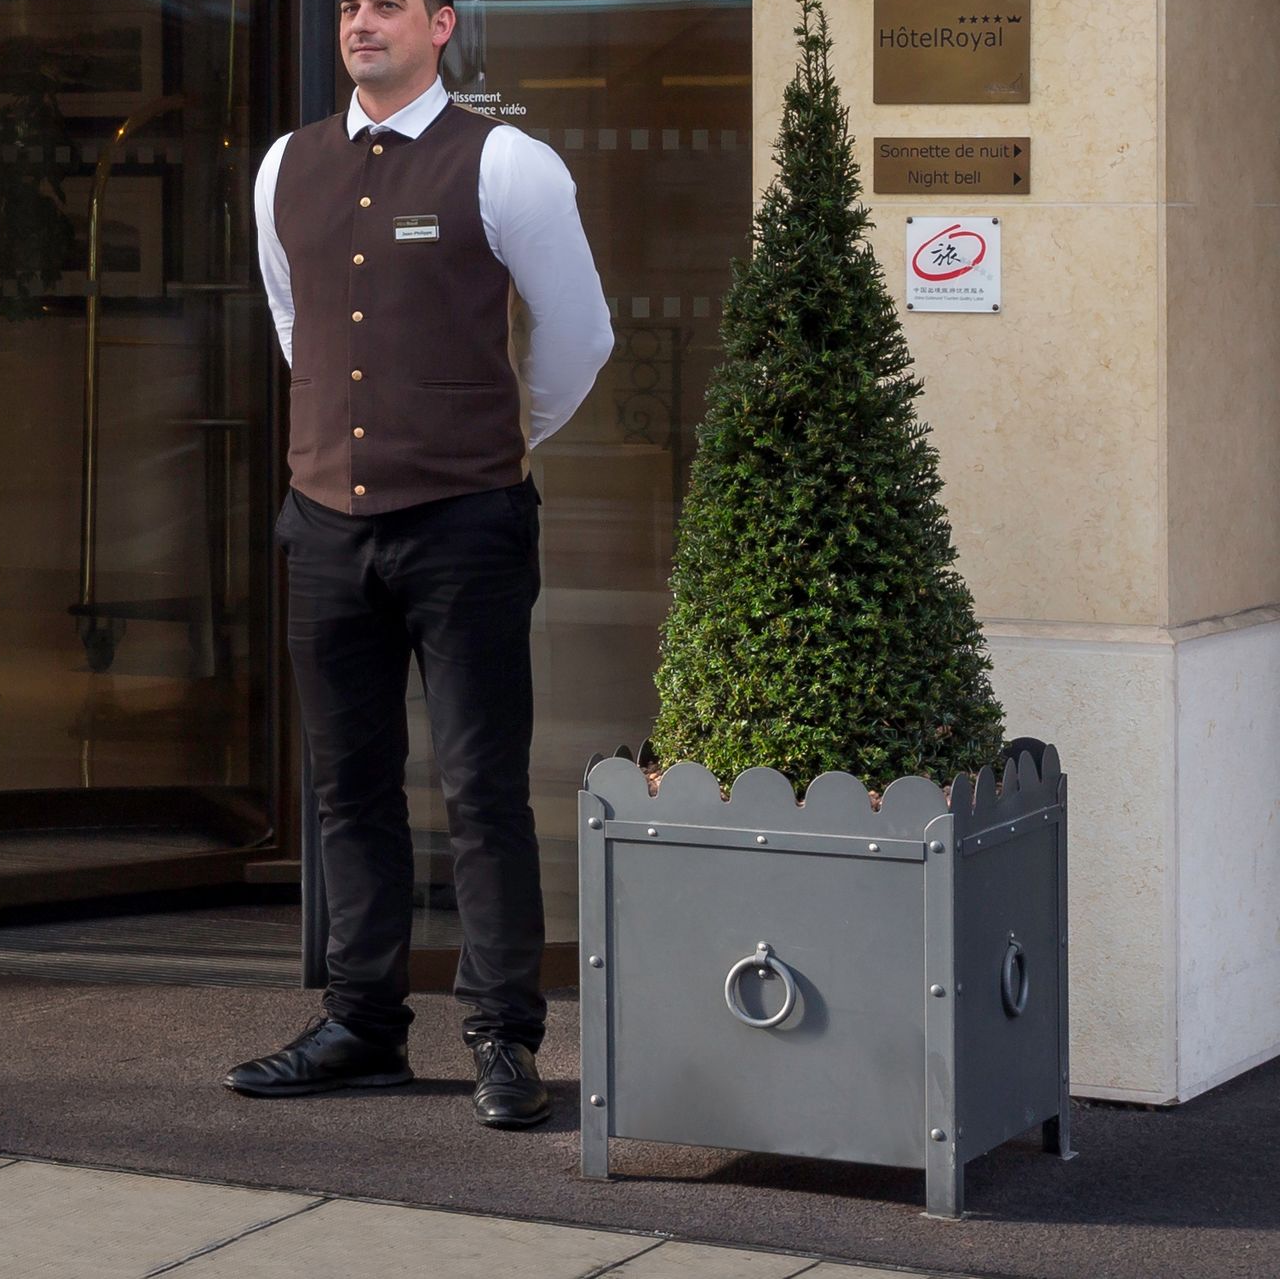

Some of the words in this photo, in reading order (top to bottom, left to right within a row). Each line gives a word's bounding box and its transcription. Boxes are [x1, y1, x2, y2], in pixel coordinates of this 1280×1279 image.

[880, 26, 1003, 52] HôtelRoyal
[500, 103, 527, 115] vidéo
[880, 144, 951, 158] Sonnette
[955, 144, 975, 158] de
[980, 144, 1010, 158] nuit
[908, 170, 950, 187] Night
[954, 170, 981, 185] bell
